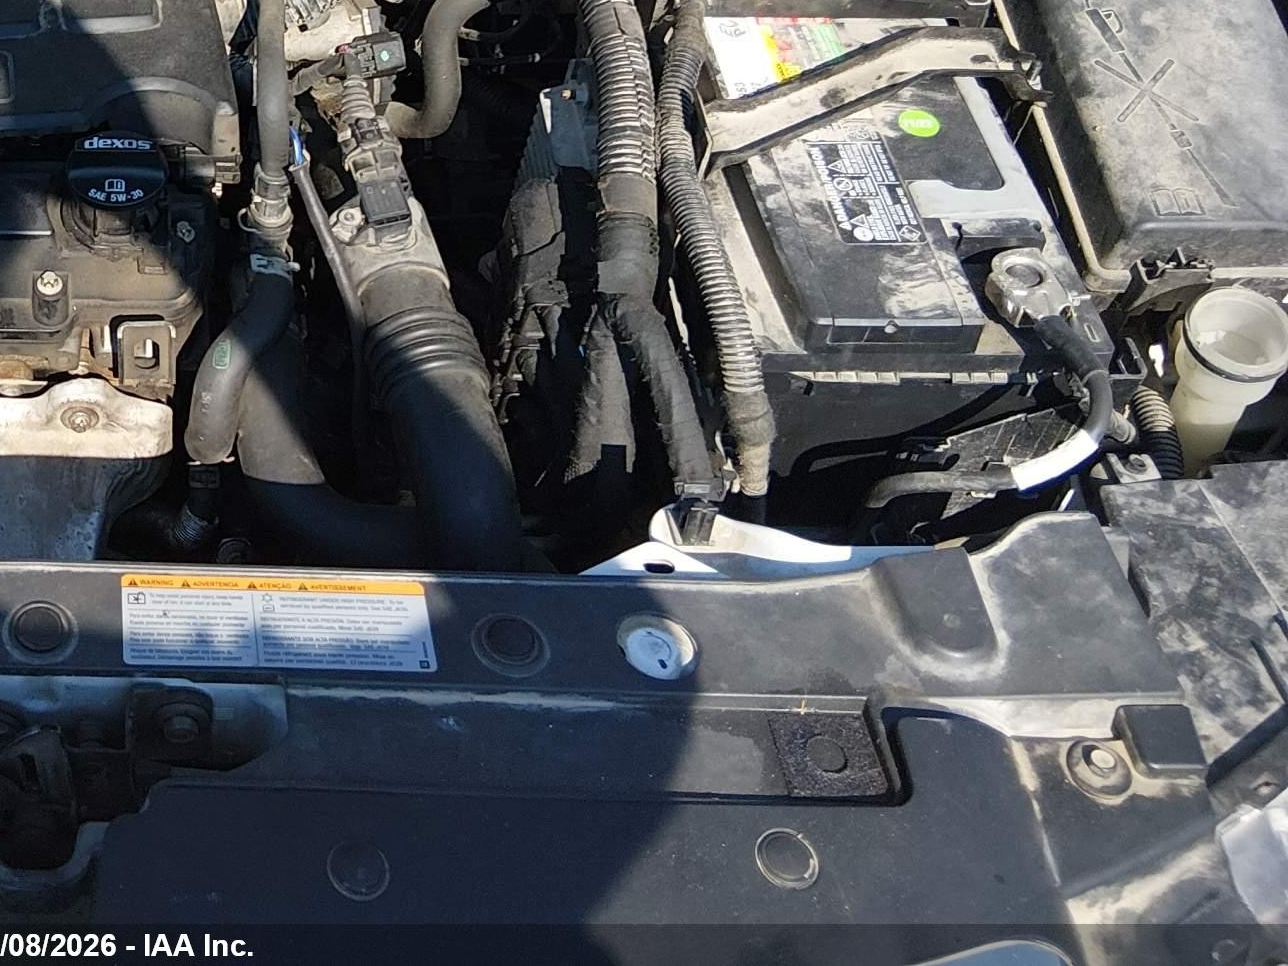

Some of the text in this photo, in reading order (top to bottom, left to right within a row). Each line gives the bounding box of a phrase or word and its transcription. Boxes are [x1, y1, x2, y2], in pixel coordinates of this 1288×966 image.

[84, 135, 154, 150] dexos
[87, 188, 144, 203] SAE 5W-30
